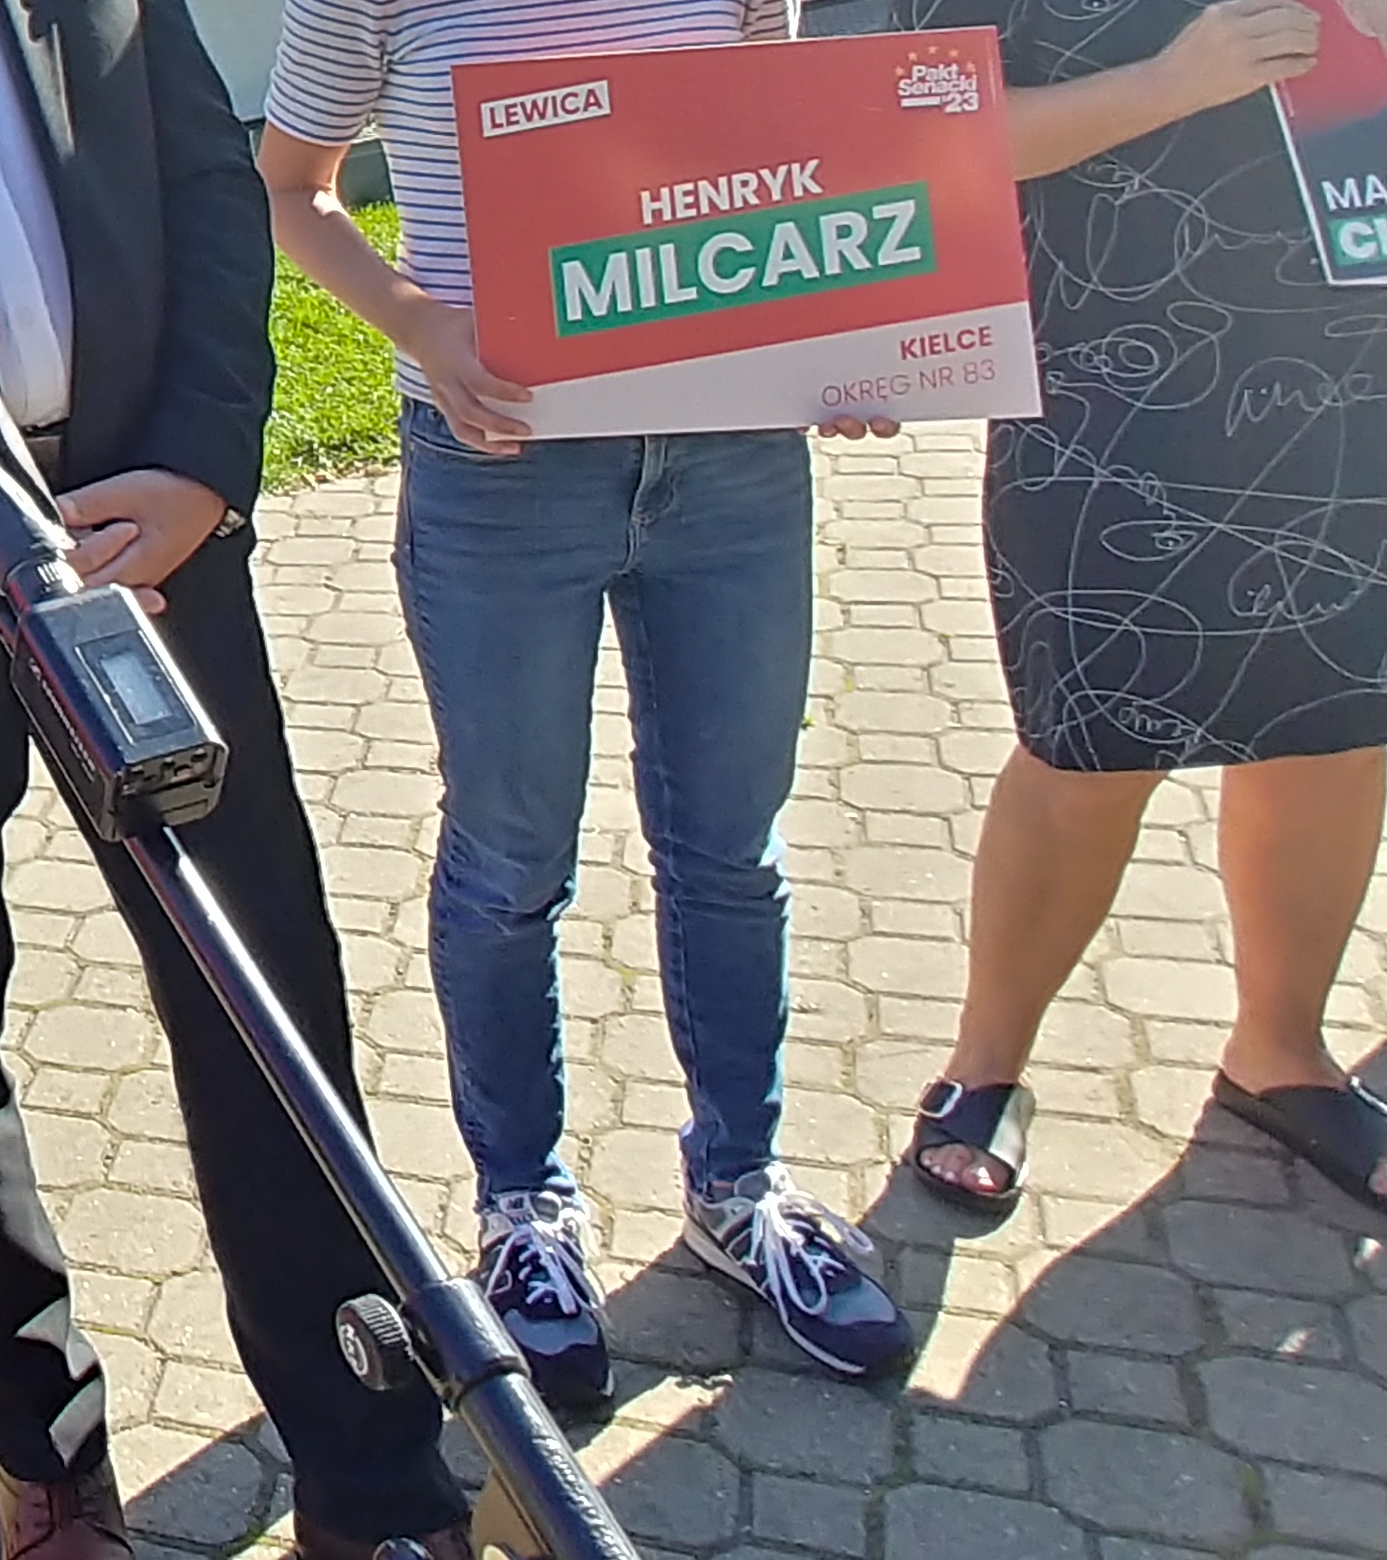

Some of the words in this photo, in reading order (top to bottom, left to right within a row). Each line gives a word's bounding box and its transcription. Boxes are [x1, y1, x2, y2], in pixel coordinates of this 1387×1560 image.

[897, 74, 978, 96] Senacki
[912, 63, 959, 81] Pakt
[488, 89, 604, 130] LEWICA
[640, 158, 824, 225] HENRYK
[561, 198, 924, 322] MILCARZ
[900, 325, 994, 361] KIELCE
[821, 372, 912, 408] OKRĘG
[917, 366, 955, 390] NR
[963, 358, 997, 385] 83
